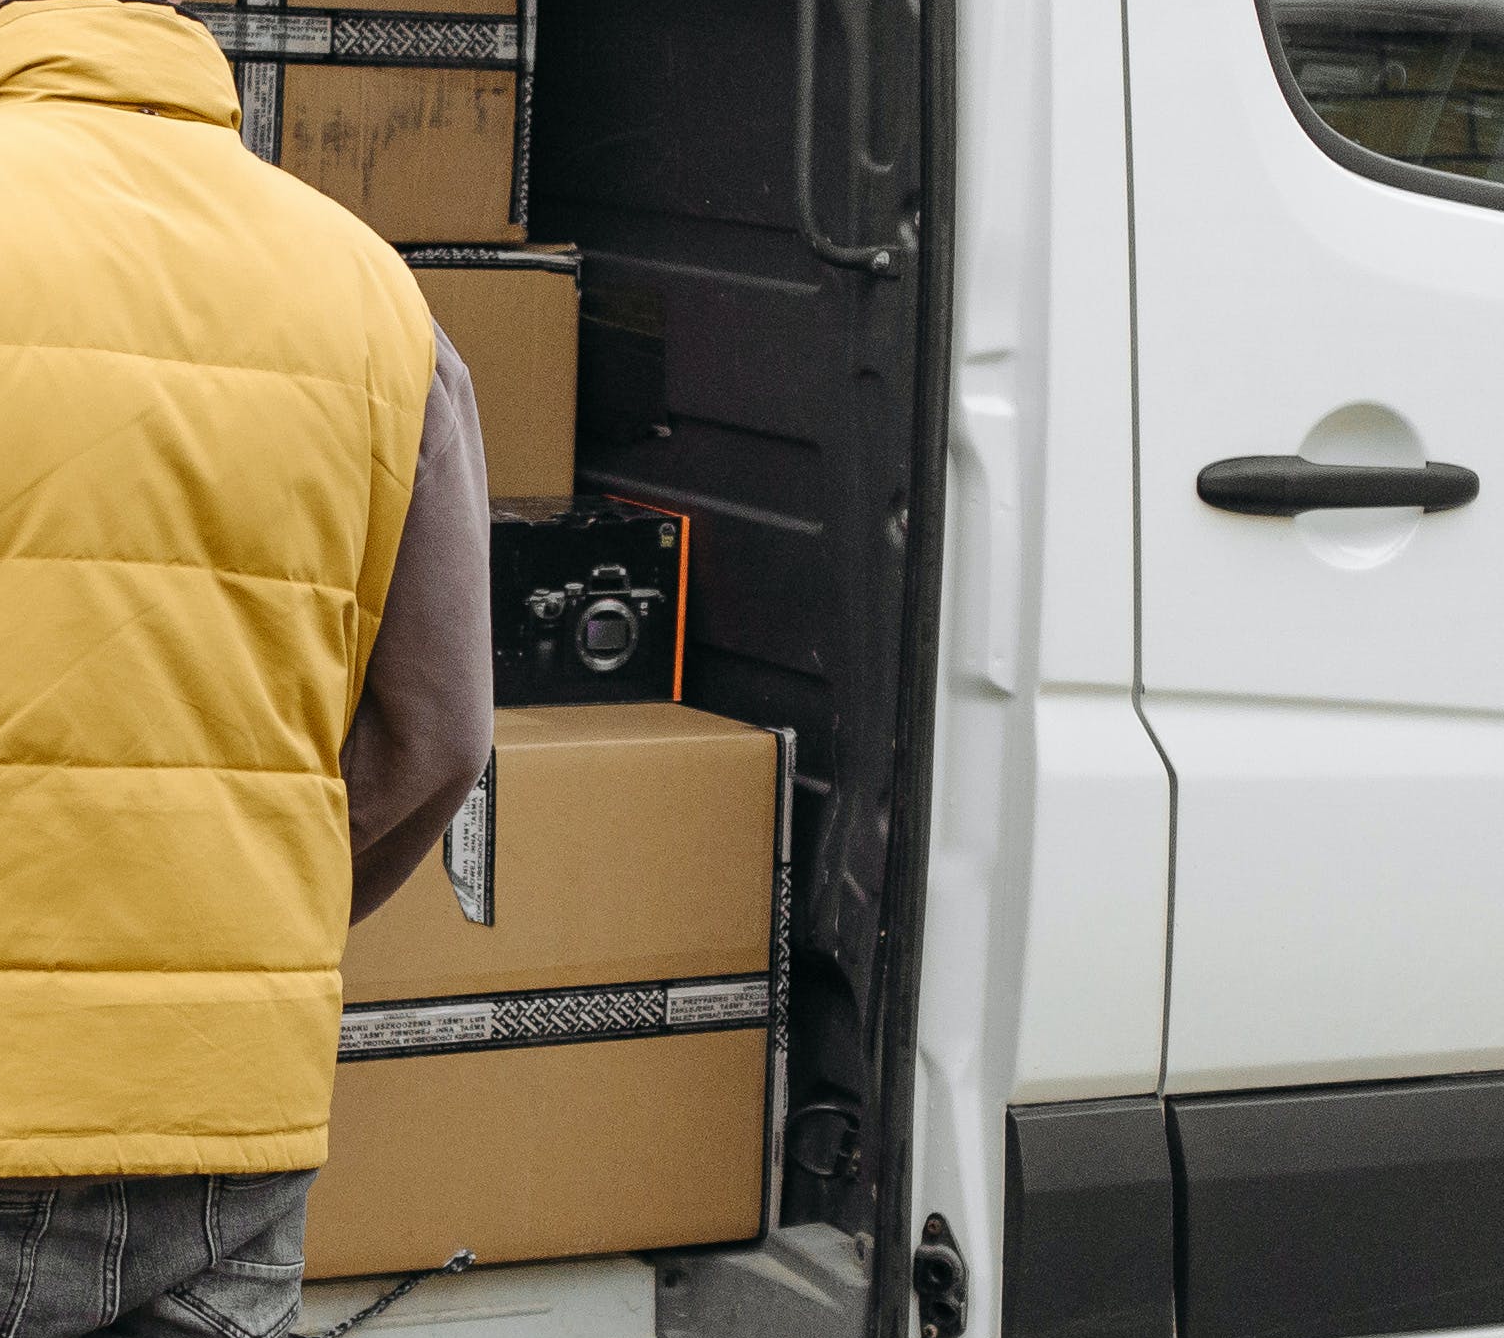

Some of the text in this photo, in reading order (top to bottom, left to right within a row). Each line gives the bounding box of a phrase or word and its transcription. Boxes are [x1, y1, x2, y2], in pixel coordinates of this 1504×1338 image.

[340, 1025, 369, 1033] PADKU
[374, 1020, 432, 1031] USZKODZENIA
[437, 1017, 464, 1025] TAŚMY
